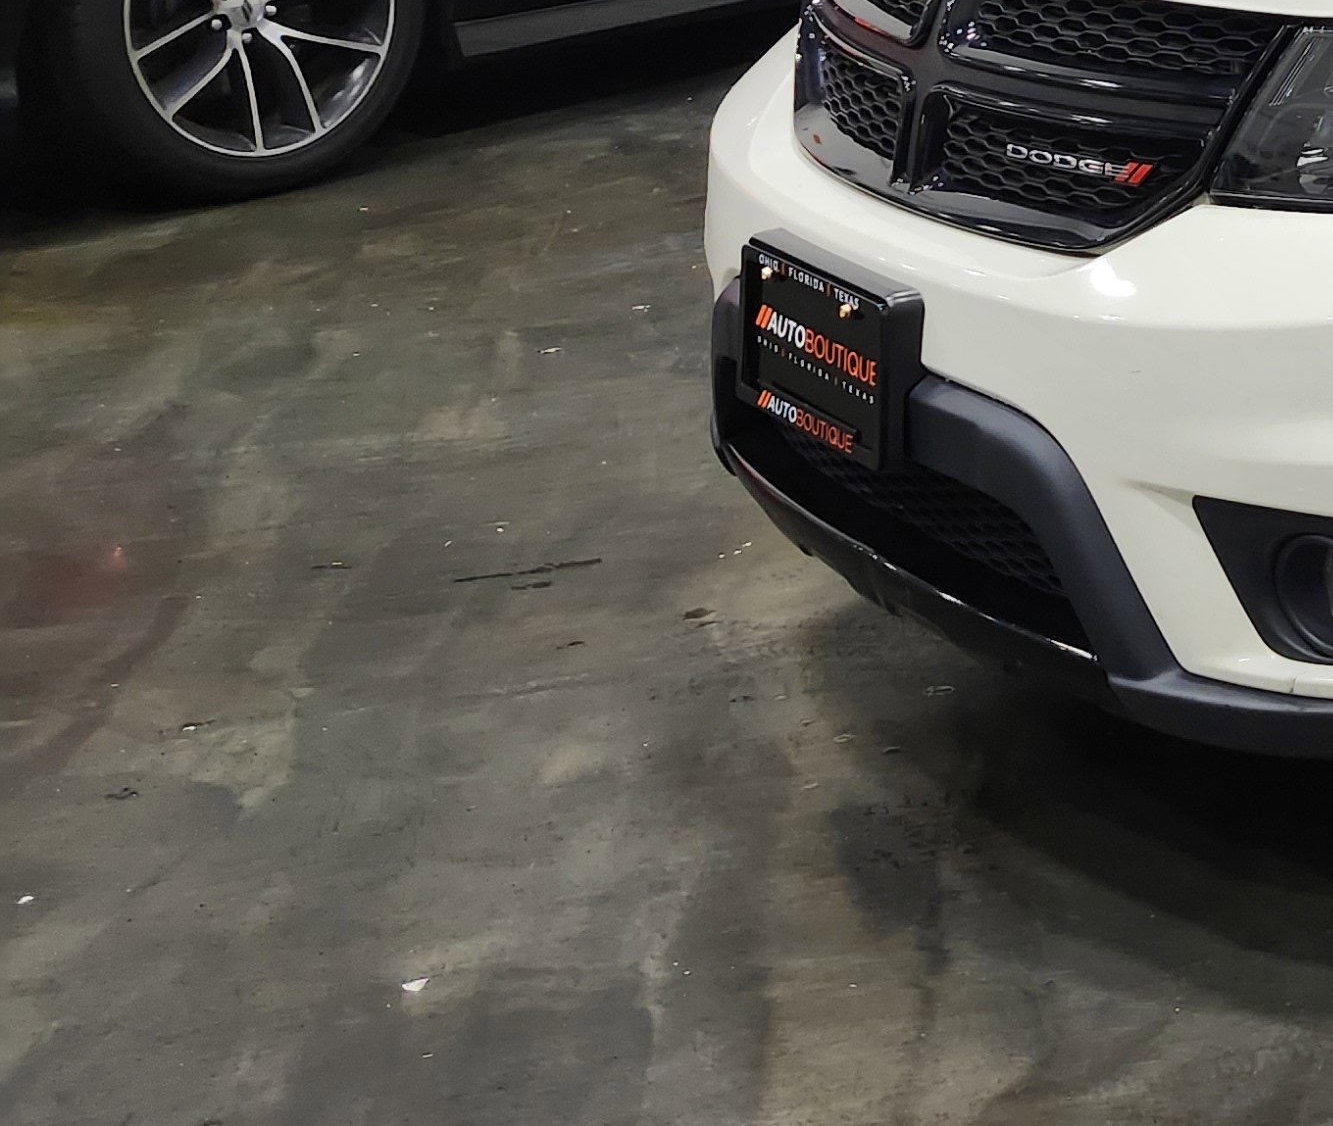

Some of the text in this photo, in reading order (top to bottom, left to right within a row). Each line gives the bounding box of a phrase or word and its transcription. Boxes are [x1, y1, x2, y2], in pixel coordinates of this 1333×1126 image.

[1006, 143, 1131, 178] DODGE
[758, 253, 860, 311] OHIO FLORIDA TEXAS
[766, 311, 878, 387] AUTOBOUTIQUE
[788, 352, 830, 381] FLORIDA
[842, 381, 875, 405] TEXAS
[766, 394, 854, 454] AUTOBOUTIQUE
